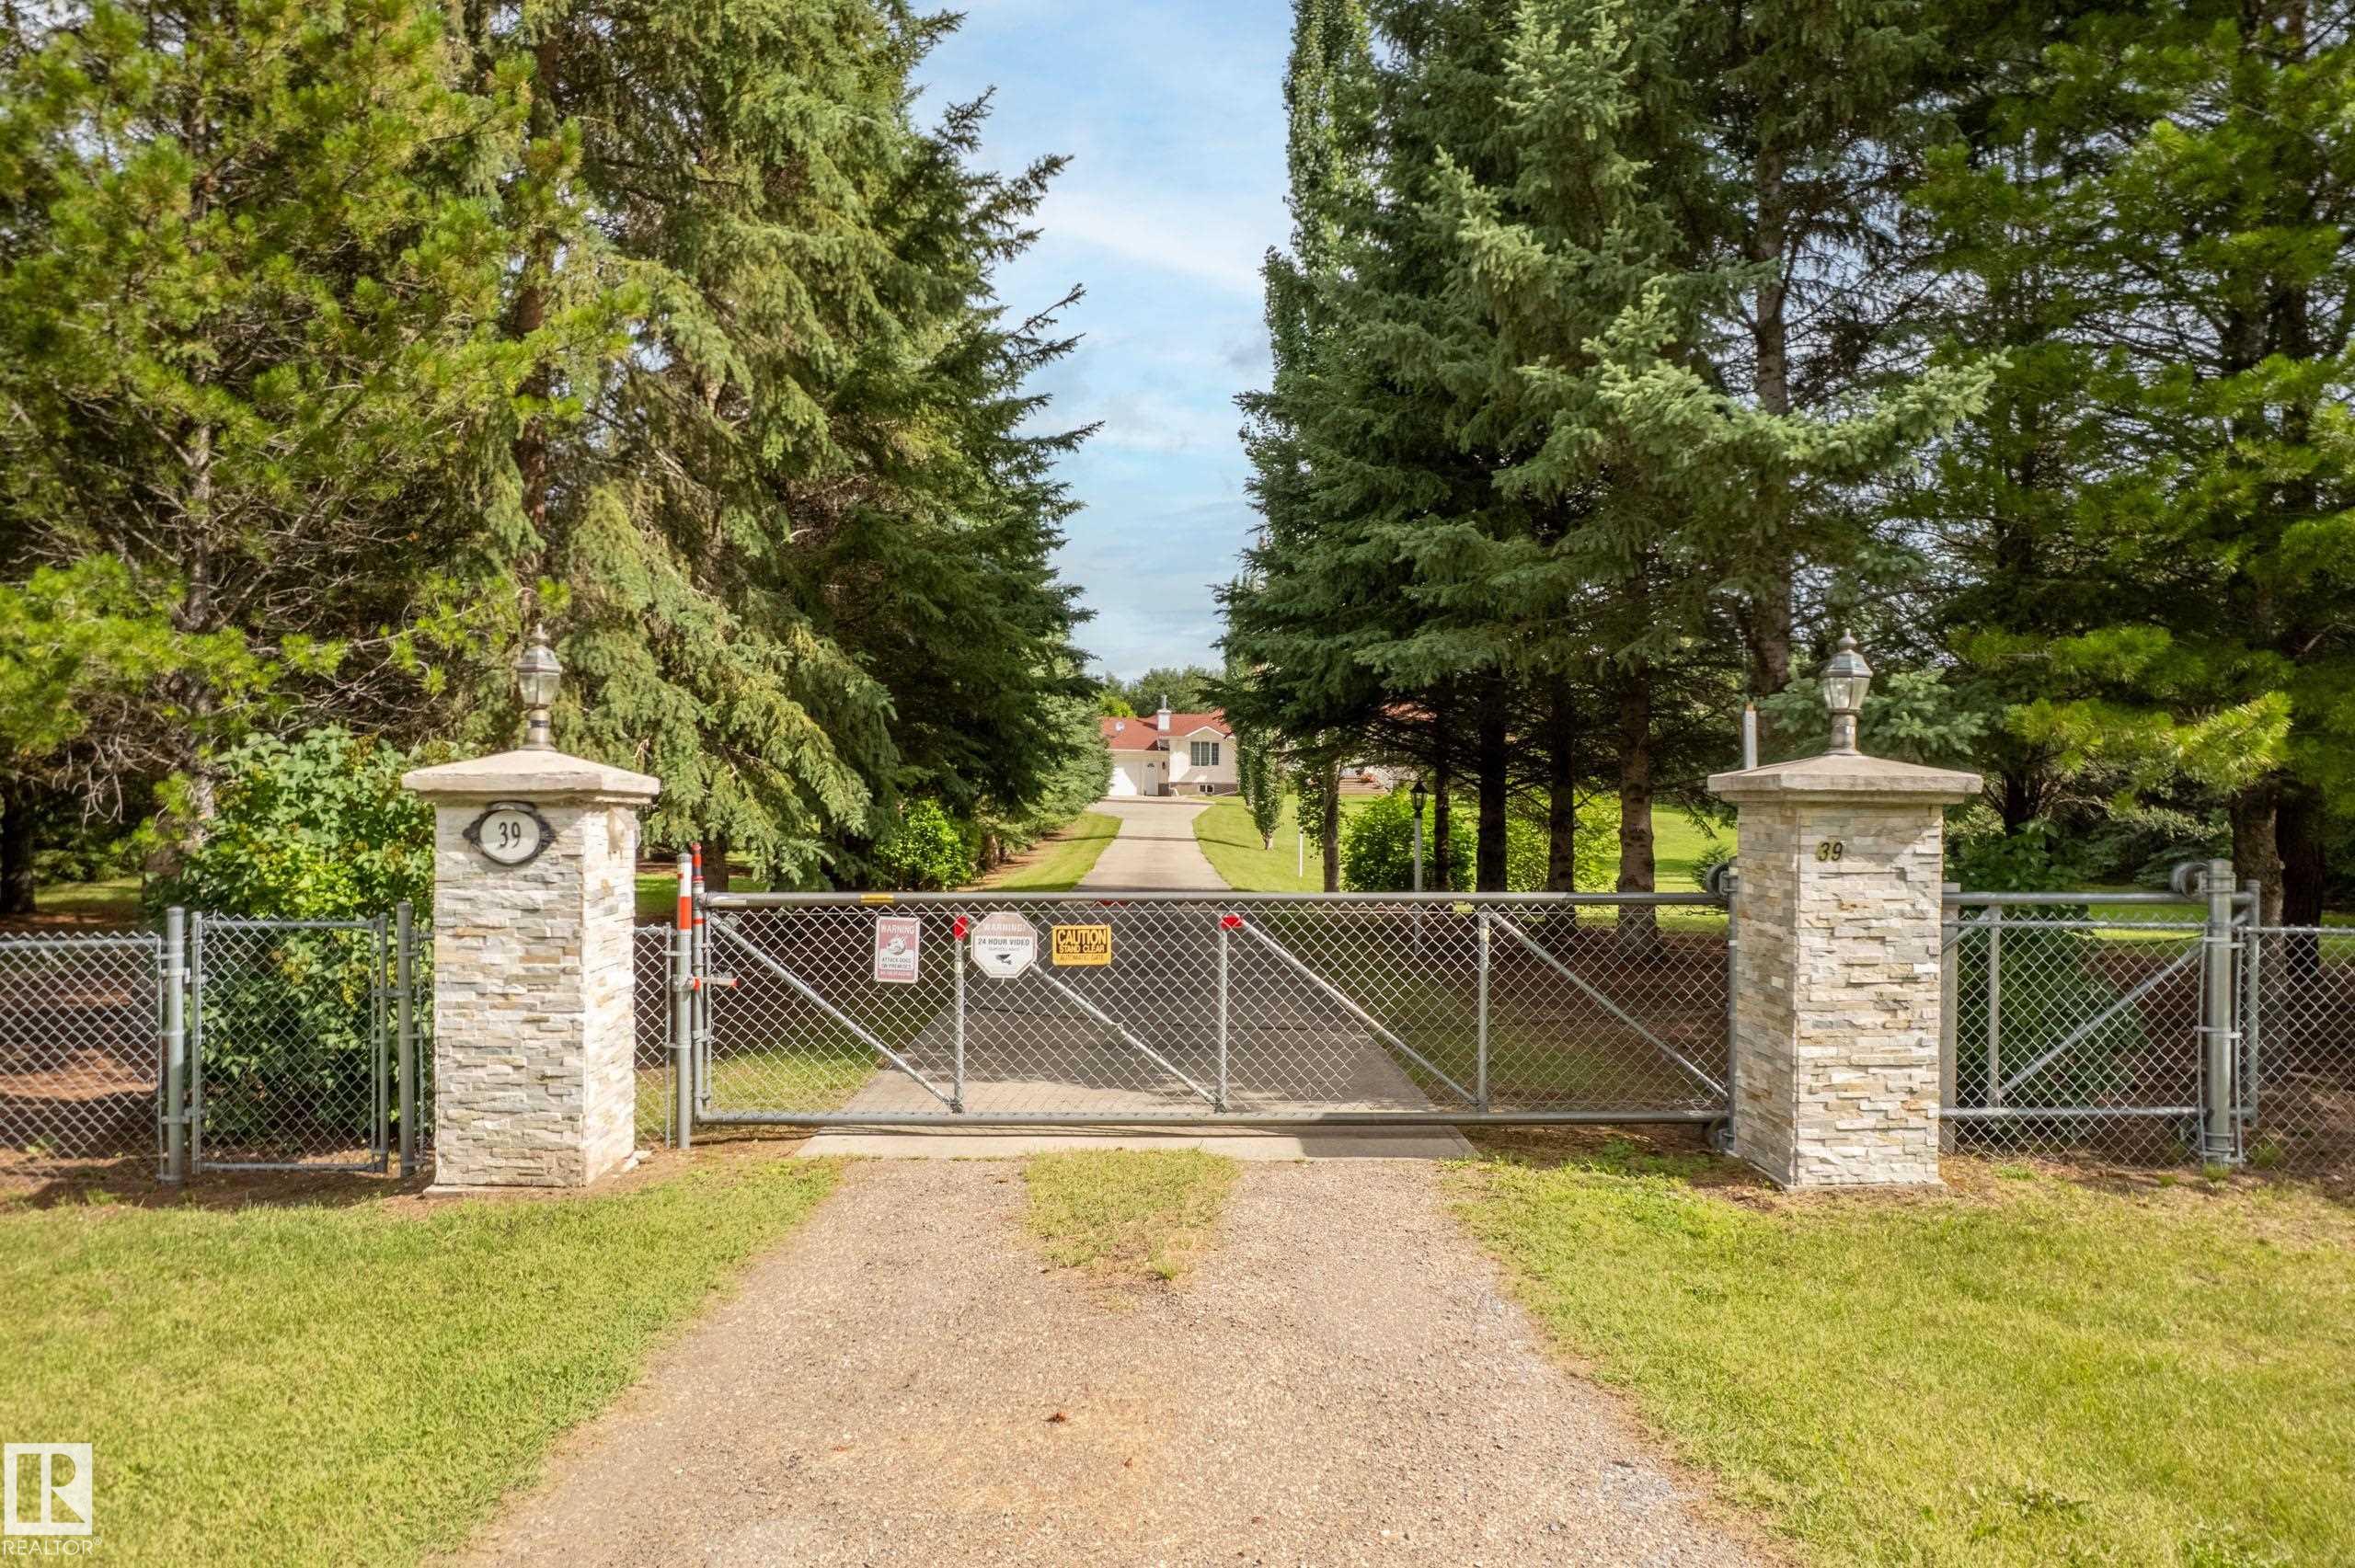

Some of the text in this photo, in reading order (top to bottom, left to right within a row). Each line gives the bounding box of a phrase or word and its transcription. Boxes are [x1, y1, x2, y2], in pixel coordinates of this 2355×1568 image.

[499, 822, 521, 848] 39
[1818, 841, 1843, 861] 39
[880, 924, 915, 933] WARNING
[1057, 929, 1107, 944] CAUTION
[1059, 944, 1105, 953] STAND CLEAR
